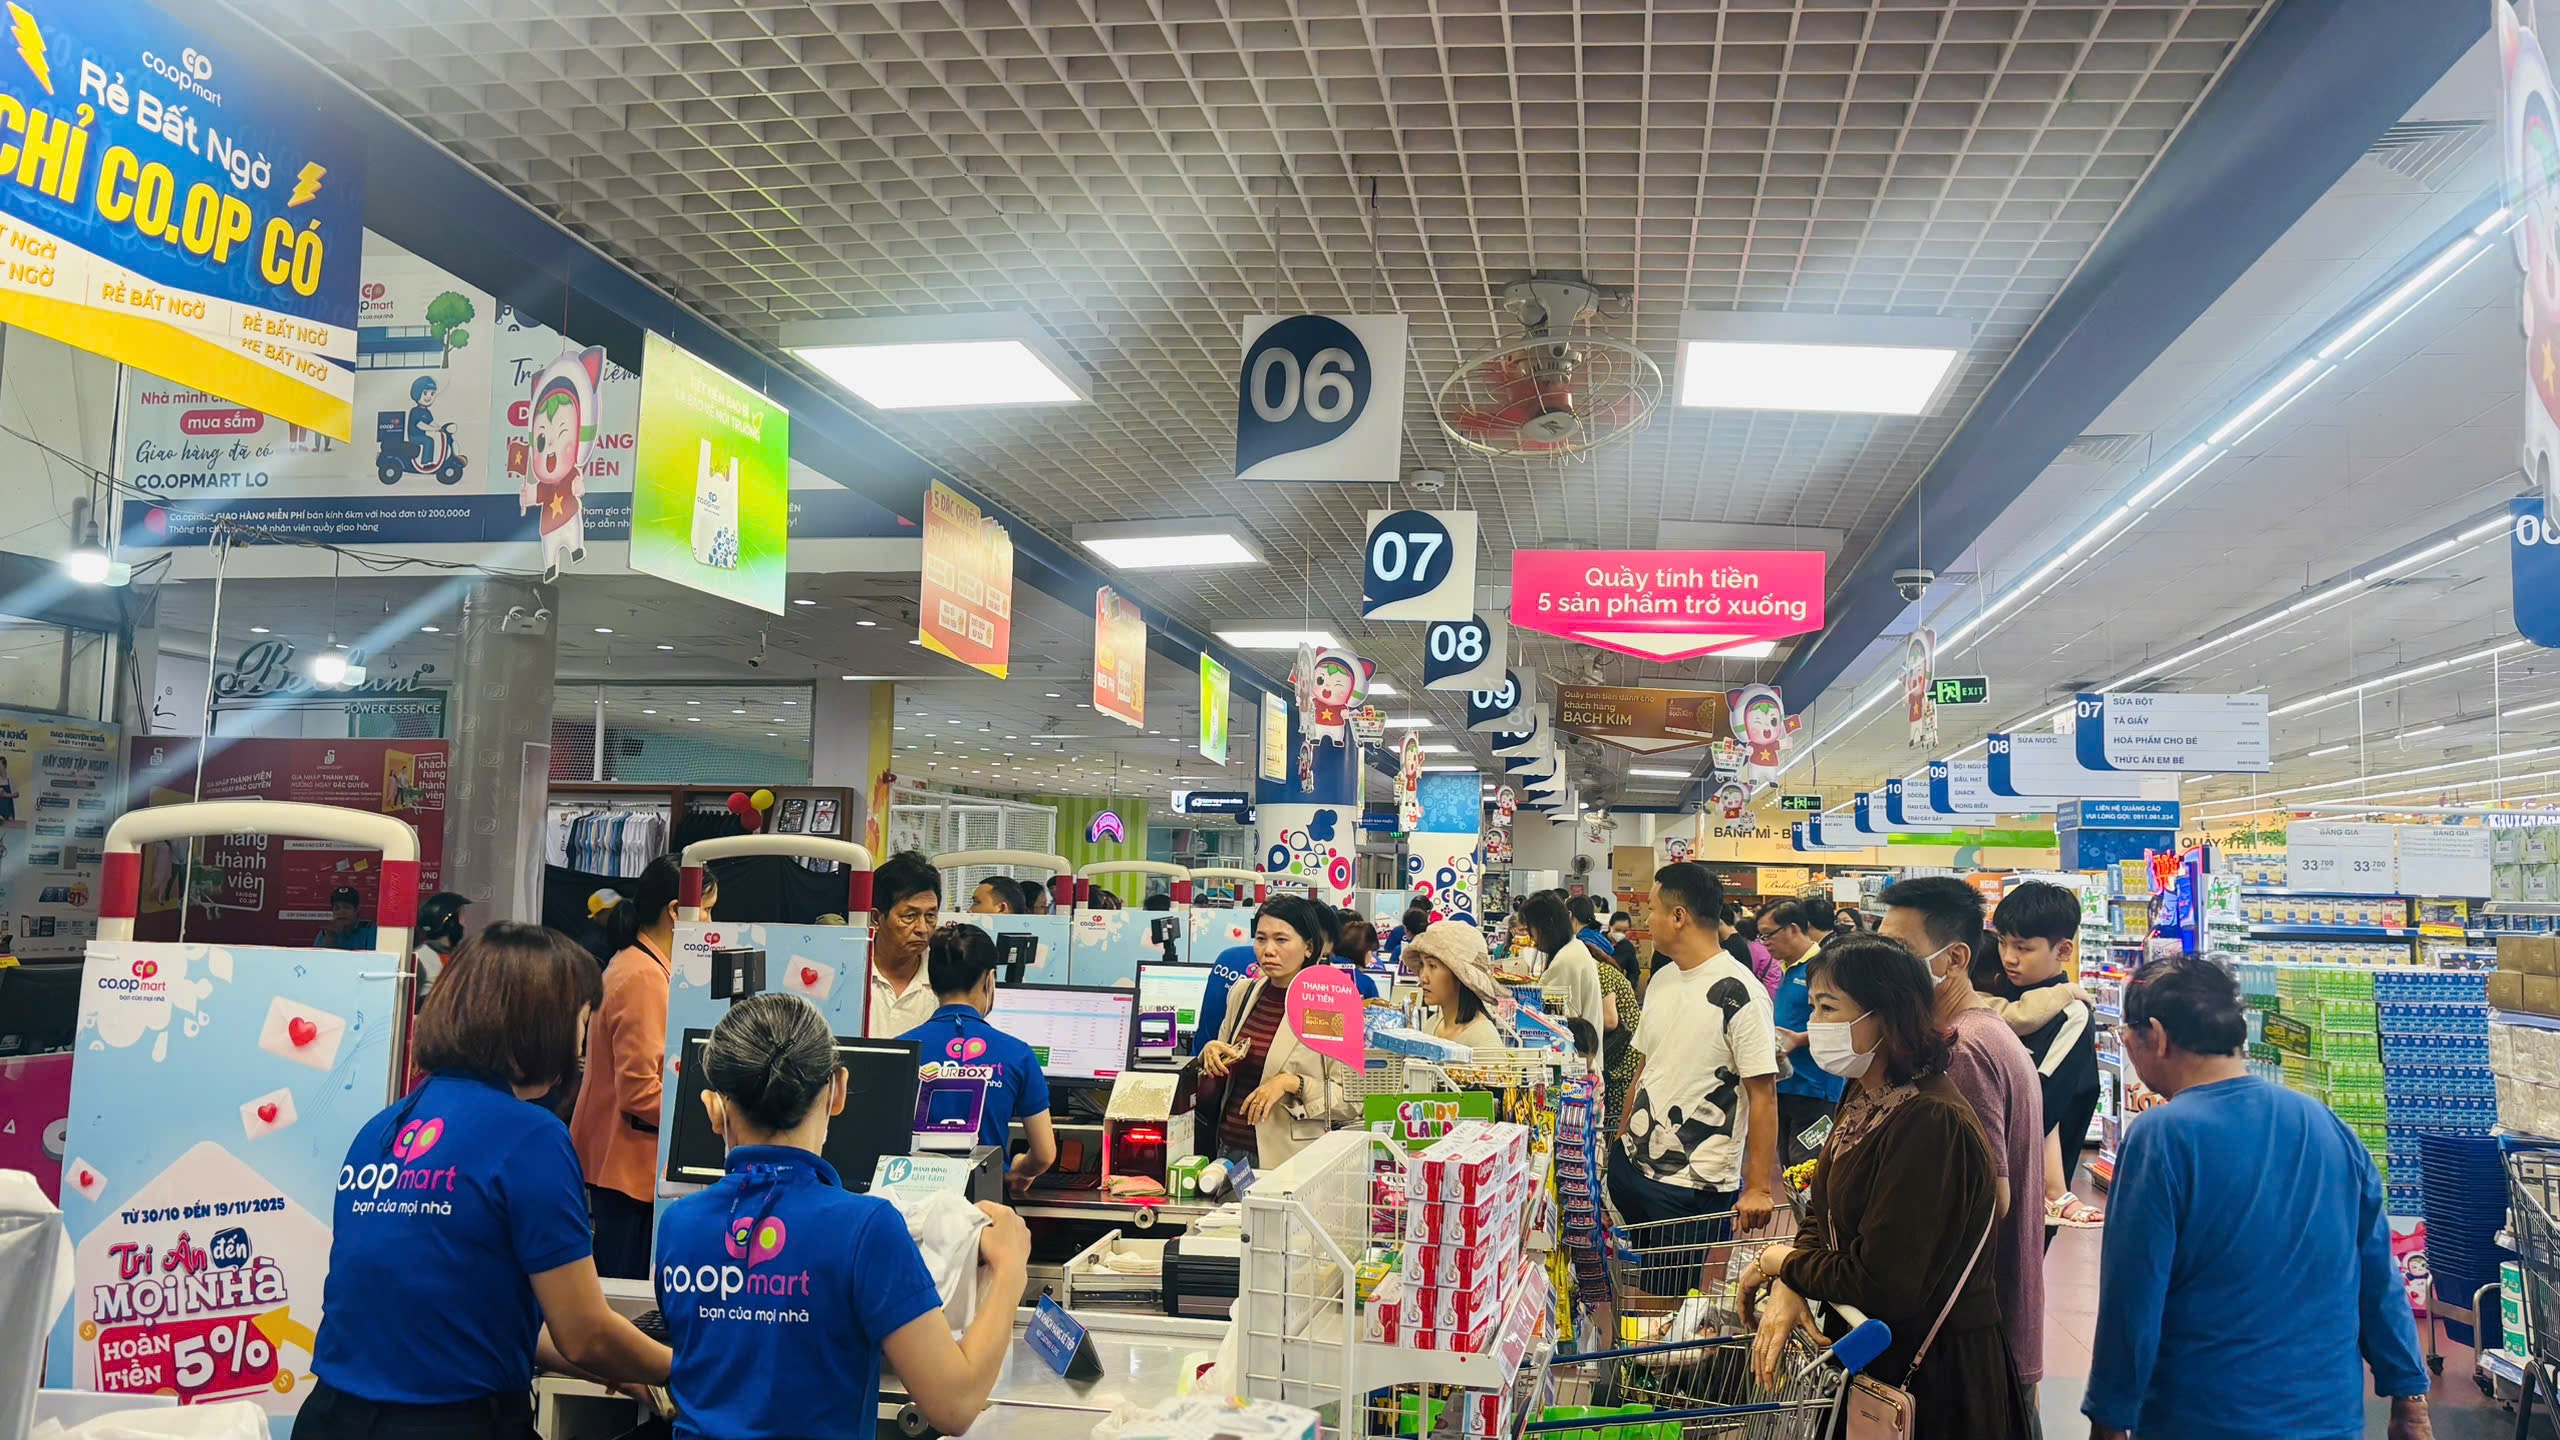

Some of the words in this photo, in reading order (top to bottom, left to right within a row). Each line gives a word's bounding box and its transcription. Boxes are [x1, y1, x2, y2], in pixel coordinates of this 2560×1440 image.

[79, 58, 130, 116] Rẻ
[136, 90, 200, 155] Bất
[207, 127, 272, 190] Ngờ
[95, 145, 253, 263] CO.OP
[260, 218, 324, 297] CÓ
[130, 288, 165, 312] BẤT
[168, 297, 207, 320] NGỜ
[265, 318, 295, 341] BẤT
[297, 326, 330, 347] NGỜ
[295, 357, 329, 381] NGỜ
[1249, 347, 1355, 424] 06
[141, 392, 170, 405] Nhà
[187, 416, 221, 430] mua
[224, 410, 256, 429] sắm
[136, 440, 178, 464] Giao
[181, 439, 224, 471] hàng
[255, 443, 274, 457] có
[135, 473, 241, 490] CO.OPMART
[245, 472, 269, 488] LO
[239, 510, 266, 520] HÀNG
[266, 507, 289, 520] MIỄN
[290, 509, 305, 519] PHÍ
[325, 510, 344, 519] kính
[344, 510, 364, 519] 6km
[428, 509, 471, 519] 200,000đ
[1372, 530, 1444, 582] 07
[1585, 564, 1649, 592] Quầy
[1655, 567, 1704, 588] tính
[1710, 566, 1759, 589] tiền
[1537, 592, 1551, 612] 5
[1557, 591, 1601, 613] sản
[1606, 590, 1678, 617] phẩm
[1684, 593, 1721, 616] trở
[1727, 588, 1808, 621] xuống
[1430, 624, 1483, 663] 08
[1961, 685, 1985, 697] EXIT
[343, 703, 386, 715] POWER
[389, 704, 442, 715] ESSENCE
[2077, 701, 2103, 719] 07
[2112, 698, 2134, 706] SỮA
[2134, 698, 2154, 707] BỘT
[1563, 710, 1603, 726] BẠCH
[1605, 713, 1632, 726] KIM
[2126, 716, 2149, 725] GIẤY
[1989, 740, 2010, 754] 08
[2163, 737, 2184, 745] CHO
[418, 760, 447, 769] khách
[2156, 756, 2171, 764] EM
[1930, 766, 1948, 779] 09
[418, 779, 446, 789] thành
[1886, 783, 1902, 795] 10
[1856, 796, 1868, 806] 11
[1792, 824, 1802, 832] 13
[1810, 816, 1821, 825] 12
[1755, 825, 1771, 839] MÌ
[214, 851, 268, 871] thành
[2302, 859, 2318, 871] 33
[2353, 860, 2370, 872] 33
[2371, 860, 2386, 868] 700
[227, 871, 265, 891] viên
[97, 977, 167, 994] co.opmart
[1301, 981, 1330, 993] THANH
[1330, 984, 1353, 995] TOÁN
[1519, 1029, 1551, 1037] mentos
[1399, 1101, 1459, 1121] CANDY
[1406, 1120, 1454, 1139] LAND
[121, 1207, 140, 1225] TỪ
[142, 1206, 180, 1224] 30/10
[183, 1199, 211, 1219] ĐẾN
[213, 1196, 286, 1217] 19/11/2025
[351, 1200, 375, 1217] bạn
[376, 1198, 397, 1214] của
[397, 1200, 418, 1217] mọi
[420, 1200, 453, 1216] nhà
[108, 1241, 154, 1281] Tri
[162, 1229, 209, 1275] Ân
[212, 1235, 248, 1261] đến
[662, 1265, 811, 1302] co.opmart
[698, 1305, 726, 1322] bạn
[728, 1305, 752, 1321] của
[754, 1308, 777, 1326] mọi
[778, 1309, 810, 1323] nhà
[173, 1319, 271, 1389] 5%
